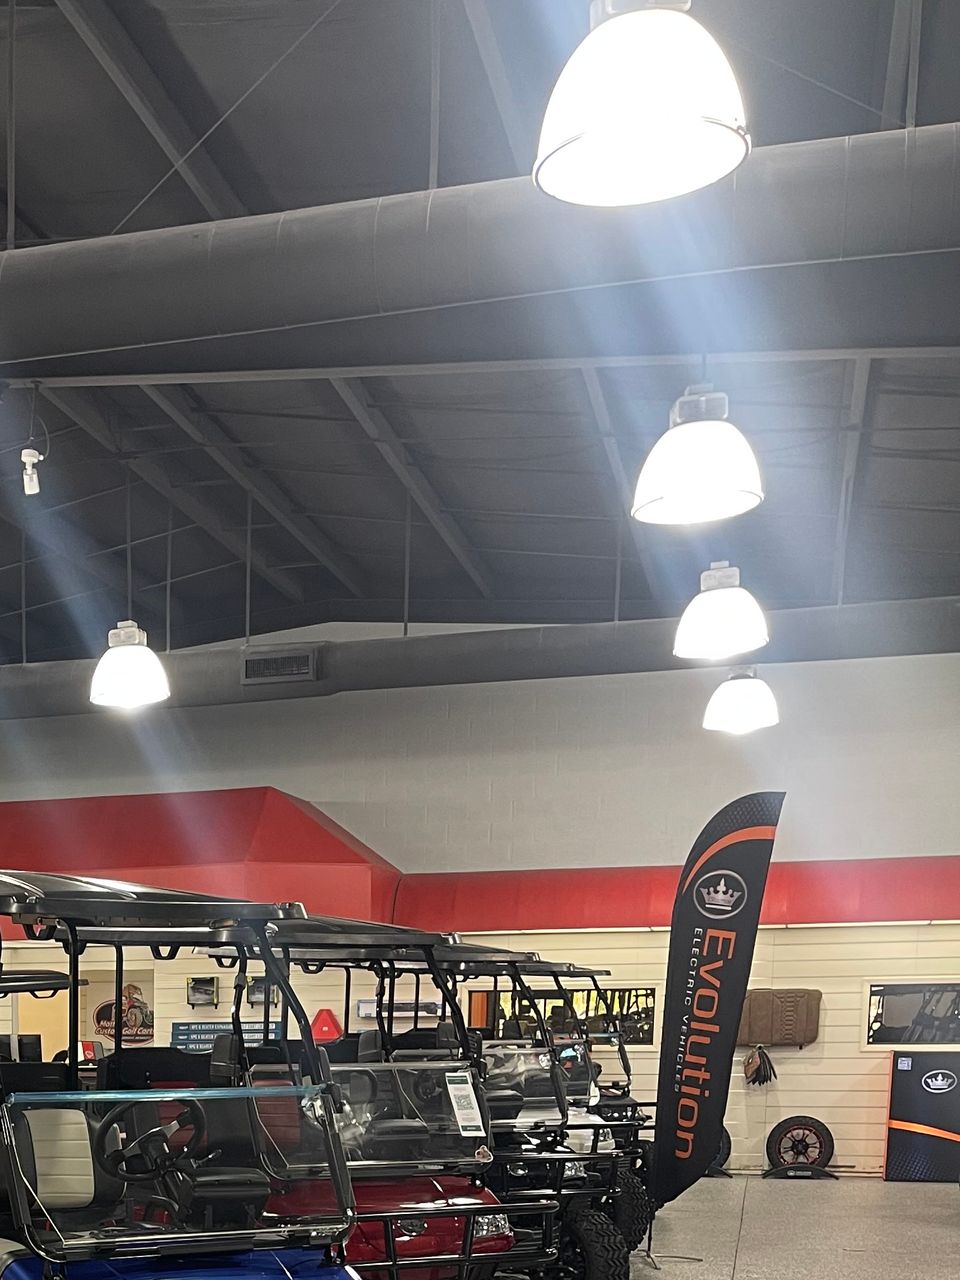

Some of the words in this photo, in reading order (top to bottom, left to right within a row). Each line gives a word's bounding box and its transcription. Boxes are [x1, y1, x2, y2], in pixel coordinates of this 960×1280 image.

[683, 927, 703, 1007] ELECTRIC
[673, 1014, 690, 1093] VEHICLES
[674, 927, 737, 1160] Evolution
